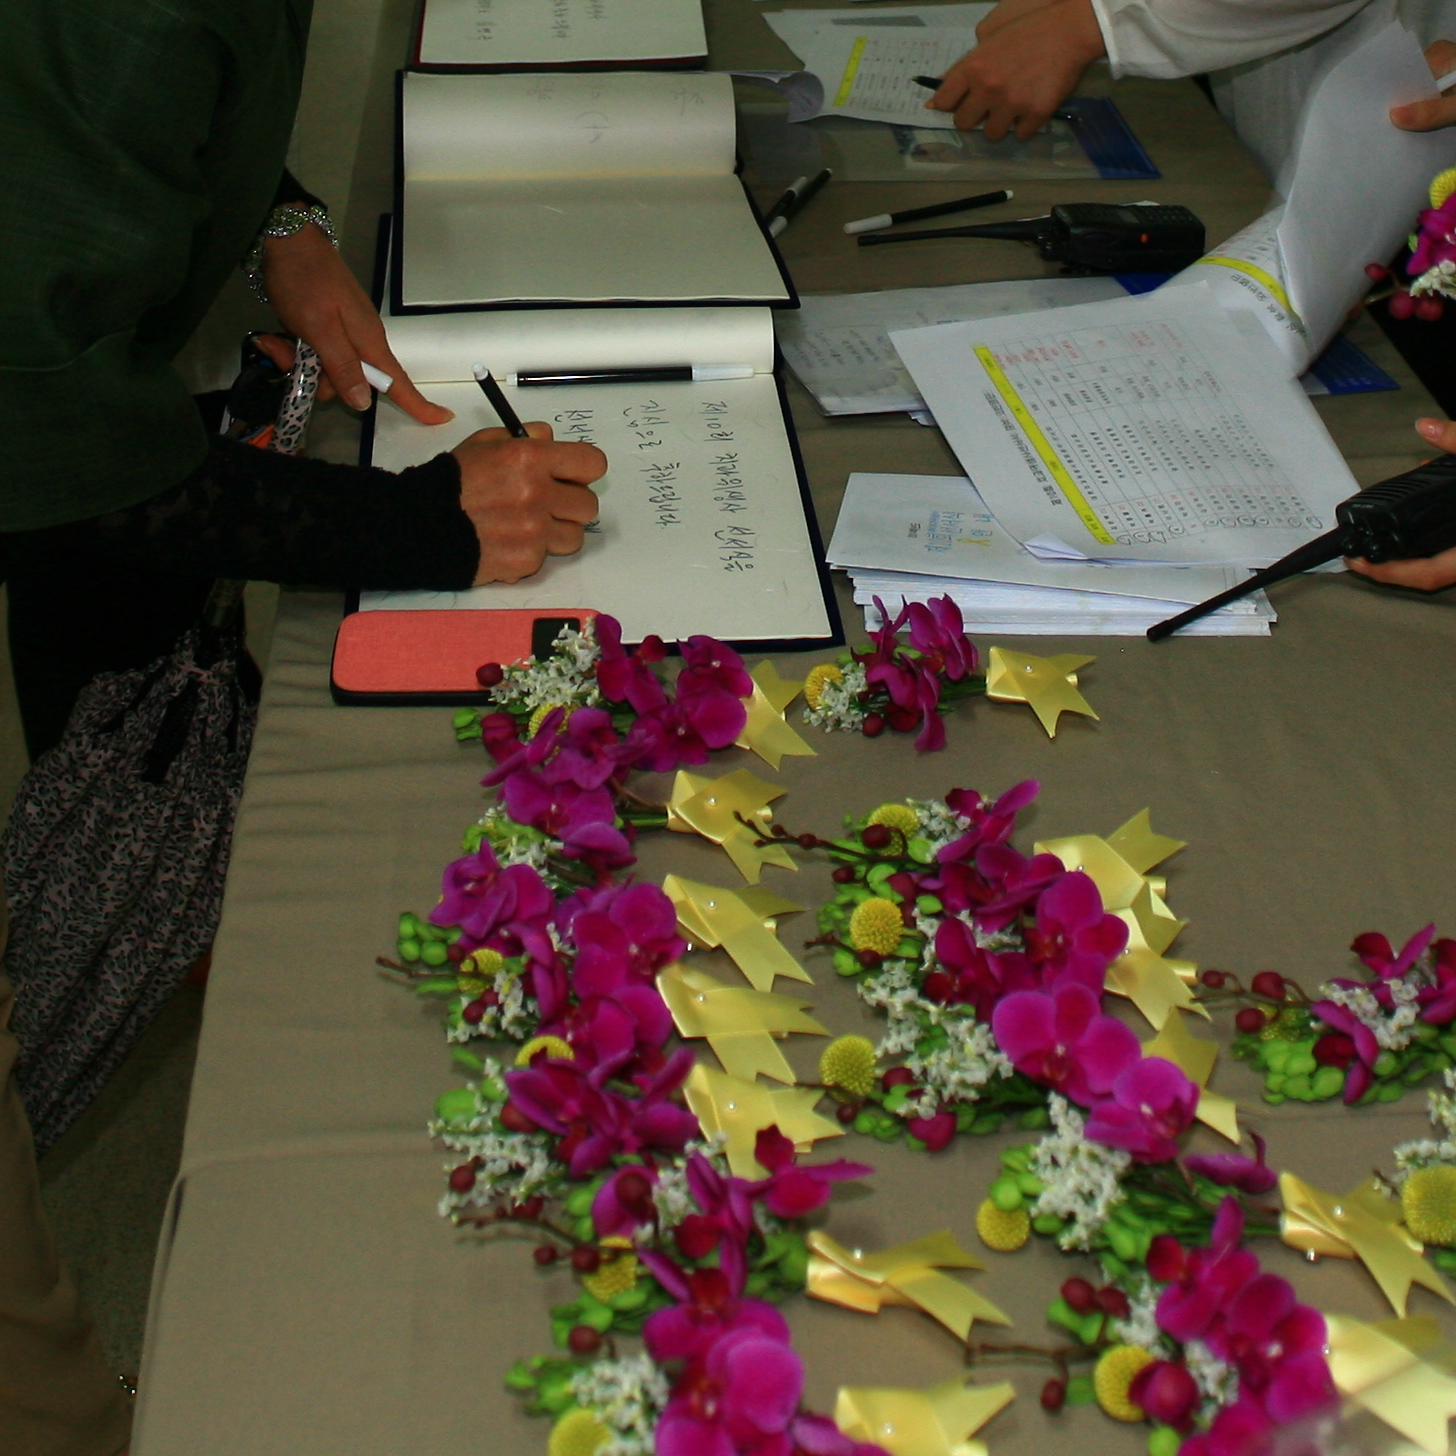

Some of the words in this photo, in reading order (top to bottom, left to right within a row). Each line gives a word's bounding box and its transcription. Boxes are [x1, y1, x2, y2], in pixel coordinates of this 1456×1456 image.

[622, 399, 670, 450] 진심으로
[698, 400, 735, 442] 제10회
[708, 452, 748, 514] 치과위생사
[713, 524, 756, 573] 선서식을
